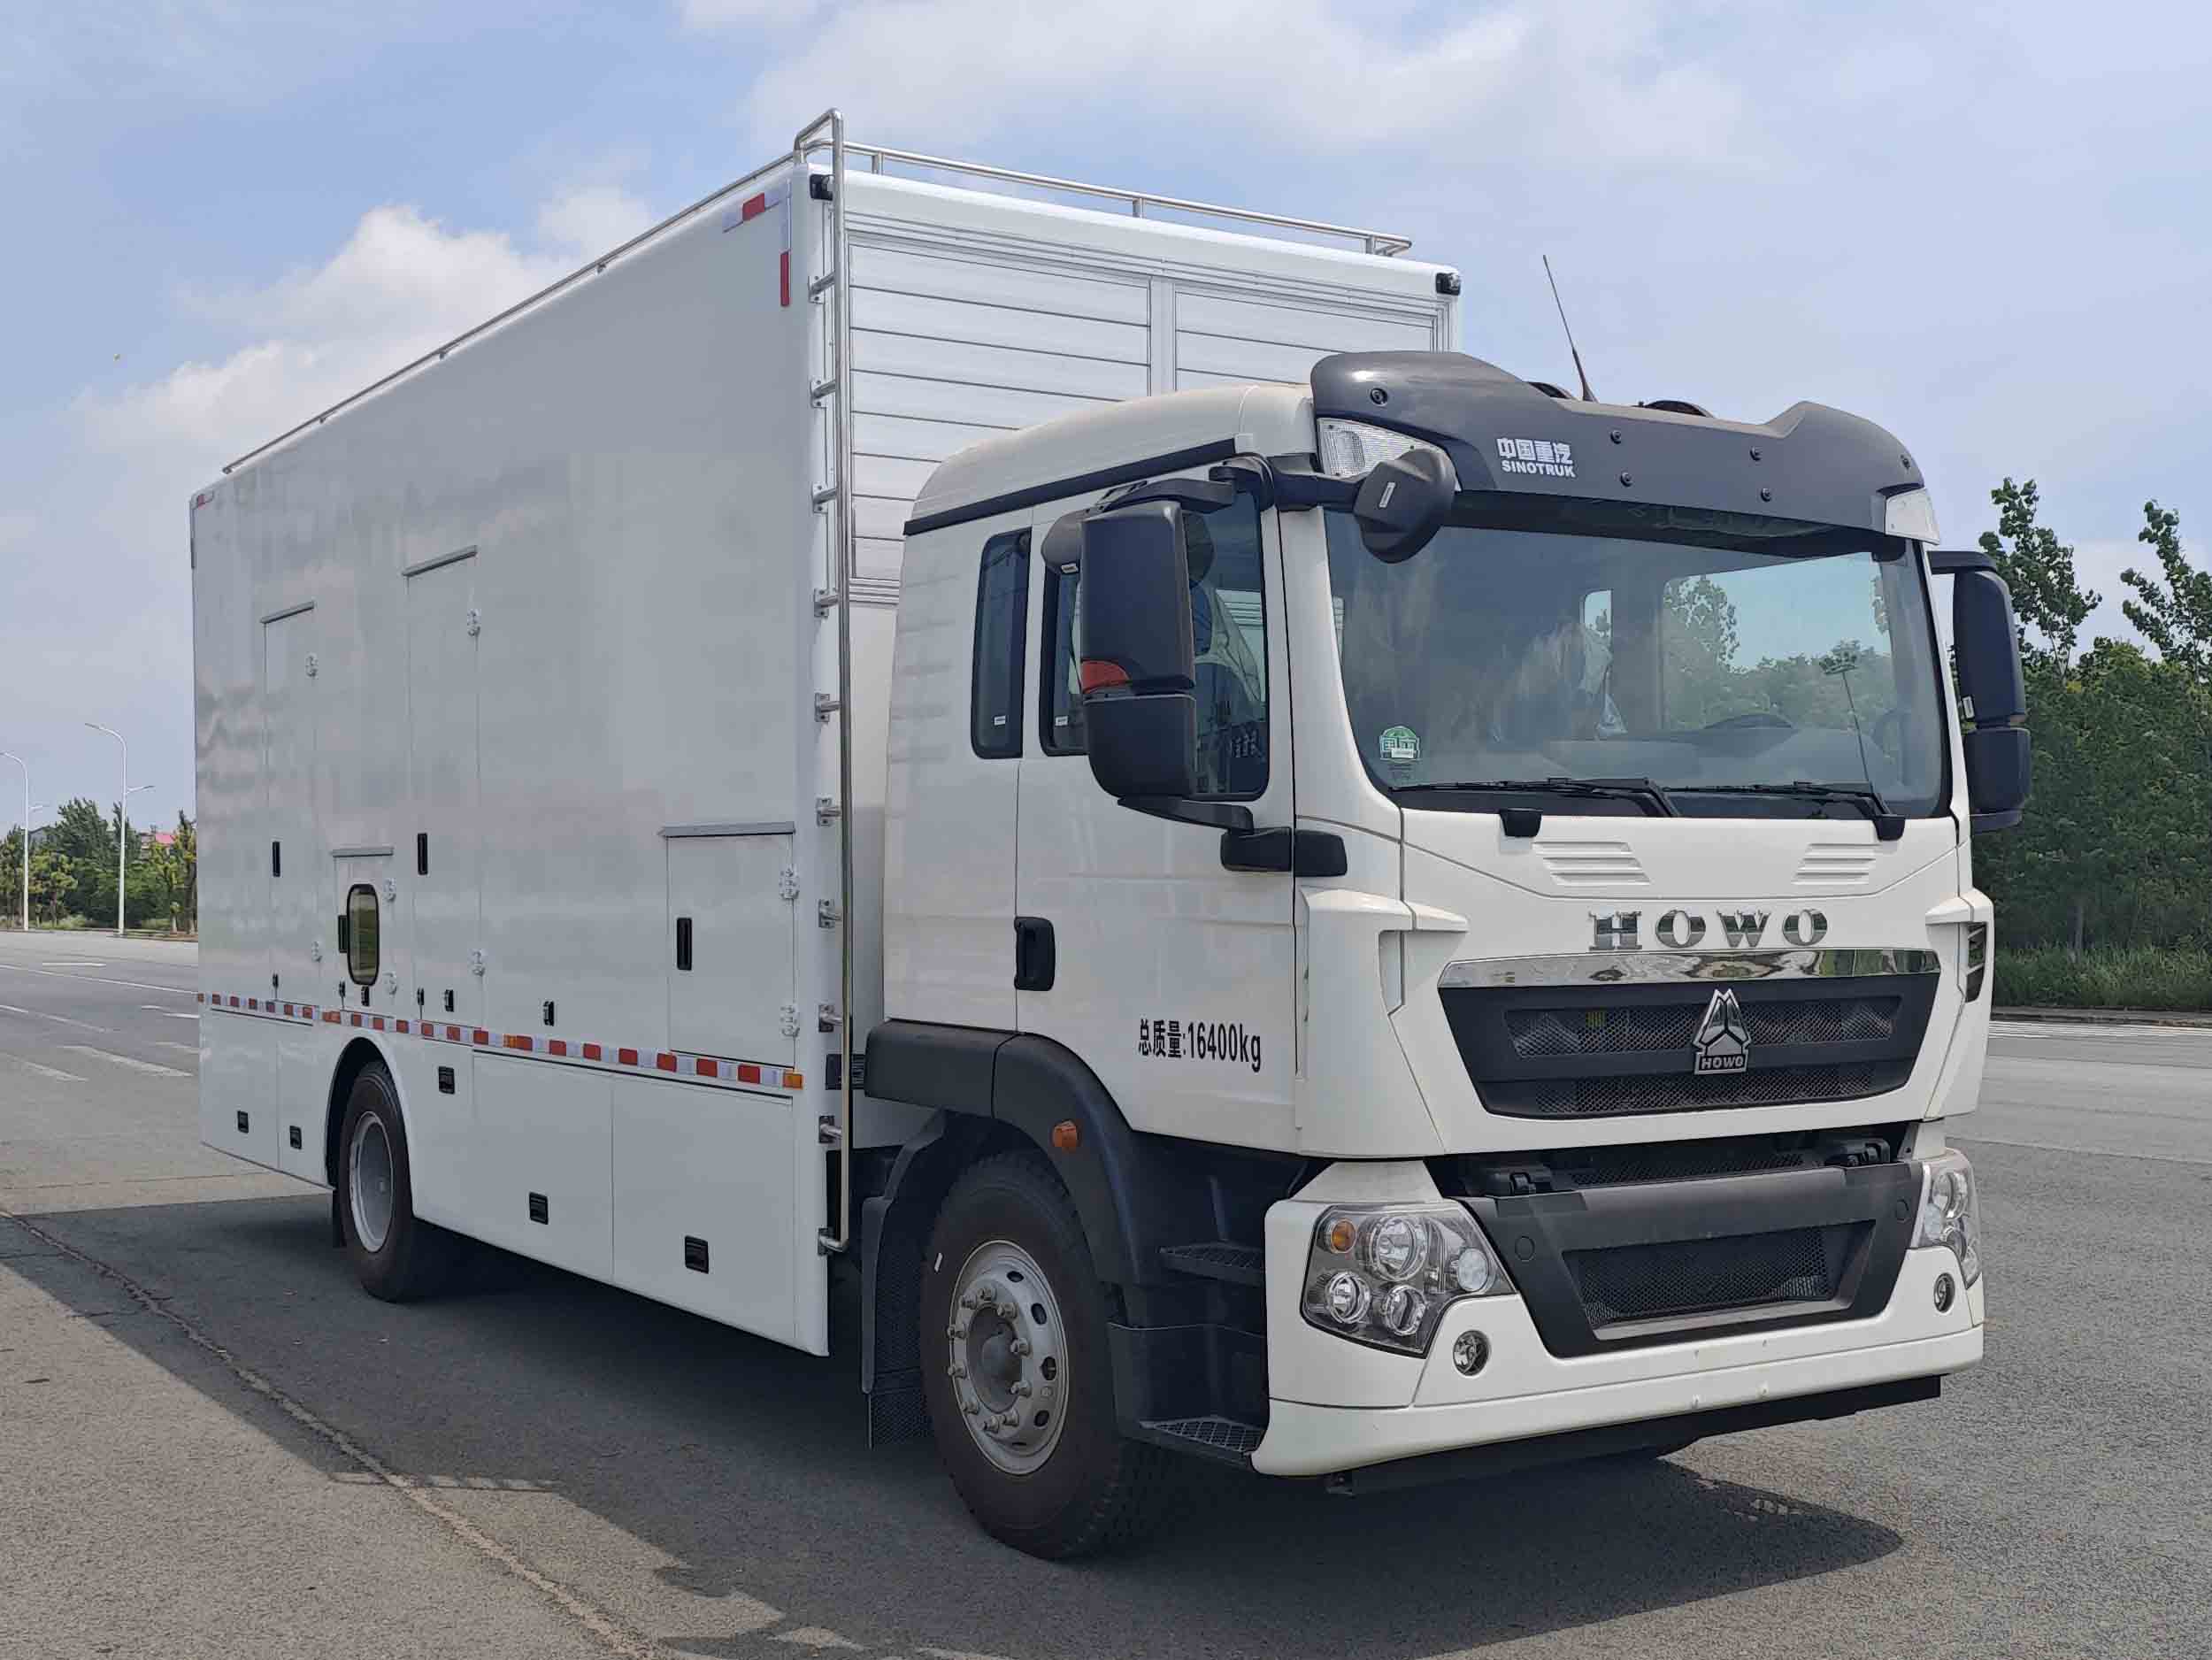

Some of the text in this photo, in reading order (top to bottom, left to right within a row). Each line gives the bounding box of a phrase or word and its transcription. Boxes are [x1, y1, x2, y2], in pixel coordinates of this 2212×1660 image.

[1496, 438, 1573, 465] 中国重汽
[1502, 460, 1577, 478] SINOTRUK
[1589, 909, 1828, 950] HOWO
[1138, 1018, 1262, 1072] 总质量:16400kg
[1701, 1056, 1743, 1069] HOWO
